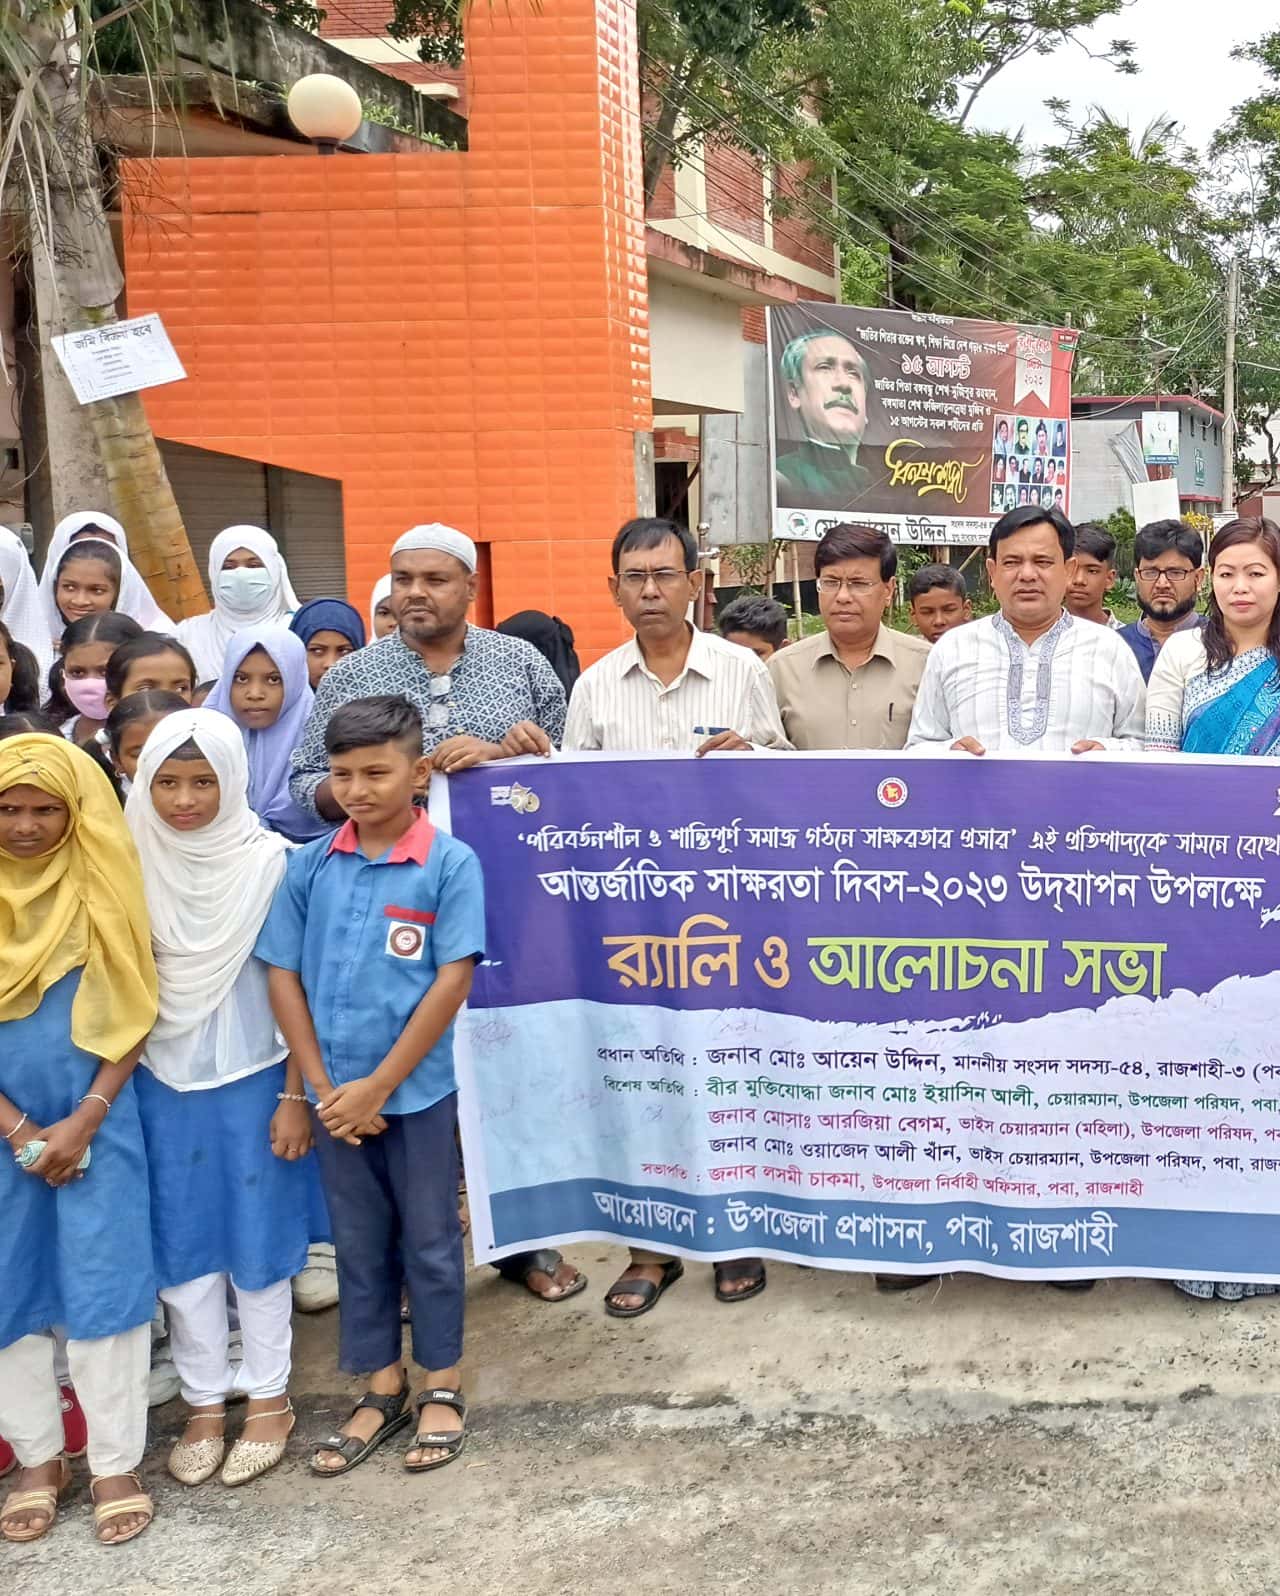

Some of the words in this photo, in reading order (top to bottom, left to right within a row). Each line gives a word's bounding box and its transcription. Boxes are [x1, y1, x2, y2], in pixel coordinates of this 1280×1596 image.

[901, 353, 923, 375] ১৫
[925, 354, 972, 379] আগস্ট
[874, 378, 895, 392] জাতির
[896, 379, 913, 394] পিতা
[905, 516, 947, 542] উদ্দিন
[648, 829, 662, 848] ও
[668, 818, 742, 853] শান্তিপূর্ণ
[746, 828, 799, 850] সমাজ
[805, 823, 856, 852] গঠনে
[863, 826, 954, 851] সাক্ষরতার
[1028, 825, 1059, 852] এই
[1066, 824, 1168, 858] প্রতিপাদ্যকে
[1174, 833, 1229, 859] সামনে
[537, 857, 700, 902] আন্তর্জাতিক
[704, 864, 825, 903] সাক্ষরতা
[831, 858, 1008, 907] দিবস-২০২৩
[1147, 864, 1266, 910] উপলক্ষে
[753, 935, 790, 990] ও
[807, 936, 1049, 994] আলোচনা
[1062, 940, 1168, 998] সভা
[597, 1047, 635, 1063] প্রধান
[639, 1045, 685, 1066] অতিথি
[706, 1045, 762, 1066] জনাব
[769, 1048, 805, 1069] মোঃ
[814, 1049, 878, 1070] আয়েন
[884, 1047, 946, 1075] উদ্দিন,
[952, 1052, 1008, 1074] মাননীয়
[1013, 1058, 1061, 1075] সংসদ
[1157, 1058, 1246, 1080] রাজশাহী-৩
[603, 1075, 642, 1092] বিশেষ
[647, 1077, 685, 1096] অতিথি
[706, 1076, 740, 1098] বীর
[744, 1076, 822, 1100] মুক্তিযোদ্ধা
[828, 1084, 876, 1102] জনাব
[882, 1087, 917, 1104] মোঃ
[923, 1081, 987, 1104] ইয়াসিন
[991, 1084, 1040, 1110] আলী,
[1047, 1092, 1123, 1109] চেয়ারম্যান,
[1128, 1092, 1188, 1110] উপজেলা
[1194, 1093, 1245, 1114] পরিষদ,
[708, 1107, 756, 1125] জনাব
[763, 1109, 811, 1129] মোসাঃ
[817, 1109, 893, 1132] আরজিয়া
[898, 1115, 951, 1135] বেগম,
[958, 1115, 994, 1134] ভাইস
[1000, 1122, 1070, 1138] চেয়ারম্যান
[1075, 1119, 1136, 1140] (মহিলা),
[1141, 1121, 1201, 1140] উপজেলা
[1207, 1123, 1258, 1144] পরিষদ,
[708, 1137, 757, 1154] জনাব
[764, 1139, 794, 1157] মোঃ
[800, 1143, 869, 1160] ওয়াজেদ
[875, 1140, 917, 1163] আলী
[968, 1146, 1003, 1164] ভাইস
[1008, 1151, 1084, 1168] চেয়ারম্যান,
[1090, 1149, 1150, 1168] উপজেলা
[1155, 1151, 1207, 1171] পরিষদ,
[1213, 1155, 1245, 1173] পবা,
[641, 1163, 688, 1180] সভাপতি
[708, 1164, 756, 1182] জনাব
[762, 1164, 803, 1186] লসমী
[808, 1171, 865, 1193] চাকমা,
[872, 1174, 931, 1193] উপজেলা
[936, 1172, 978, 1191] নির্বাহী
[983, 1176, 1041, 1198] অফিসার,
[1048, 1181, 1080, 1198] পবা,
[1085, 1178, 1145, 1197] রাজশাহী
[592, 1190, 699, 1239] আয়োজনে
[724, 1197, 829, 1245] উপজেলা
[835, 1208, 933, 1255] প্রশাসন,
[945, 1213, 999, 1257] পবা,
[1007, 1211, 1119, 1257] রাজশাহী
